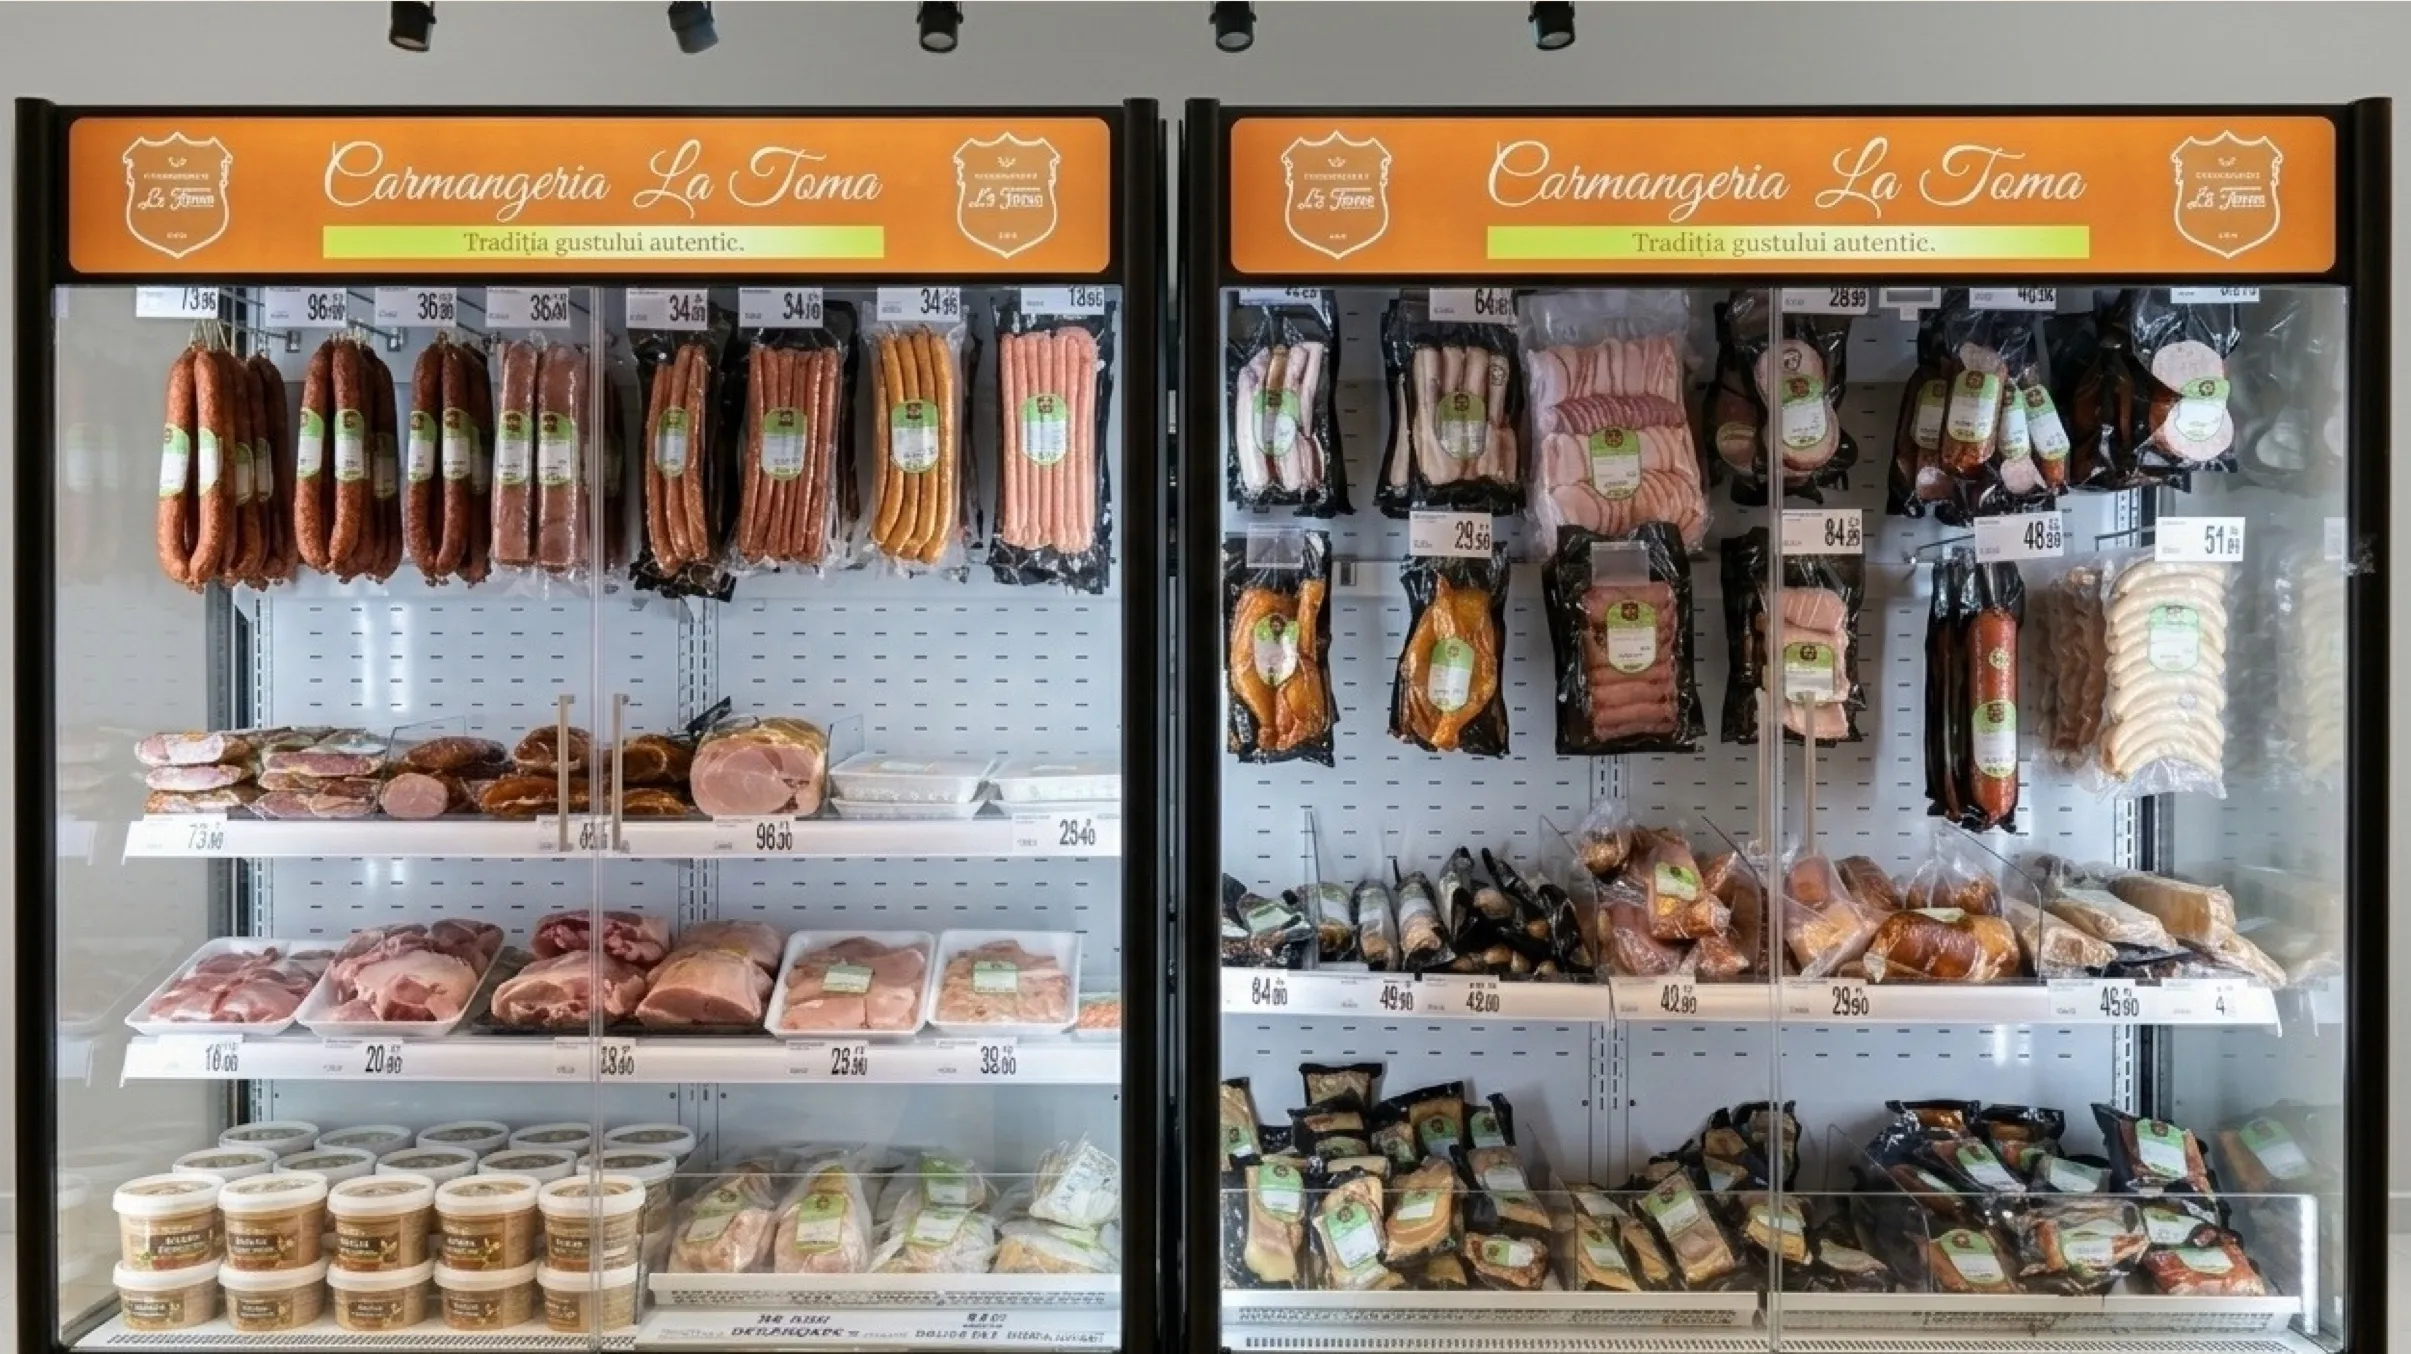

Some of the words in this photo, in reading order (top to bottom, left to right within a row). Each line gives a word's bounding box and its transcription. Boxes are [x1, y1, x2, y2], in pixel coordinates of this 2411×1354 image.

[324, 141, 611, 223] Carmangeria
[634, 139, 716, 219] La
[729, 145, 883, 208] Toma
[1487, 140, 1791, 223] Carmangeria
[1815, 136, 1902, 218] La
[1919, 144, 2087, 208] Toma
[555, 231, 645, 255] gustului
[650, 233, 745, 253] autentic.
[1732, 231, 1827, 255] gustului
[1834, 233, 1936, 253] autentic.
